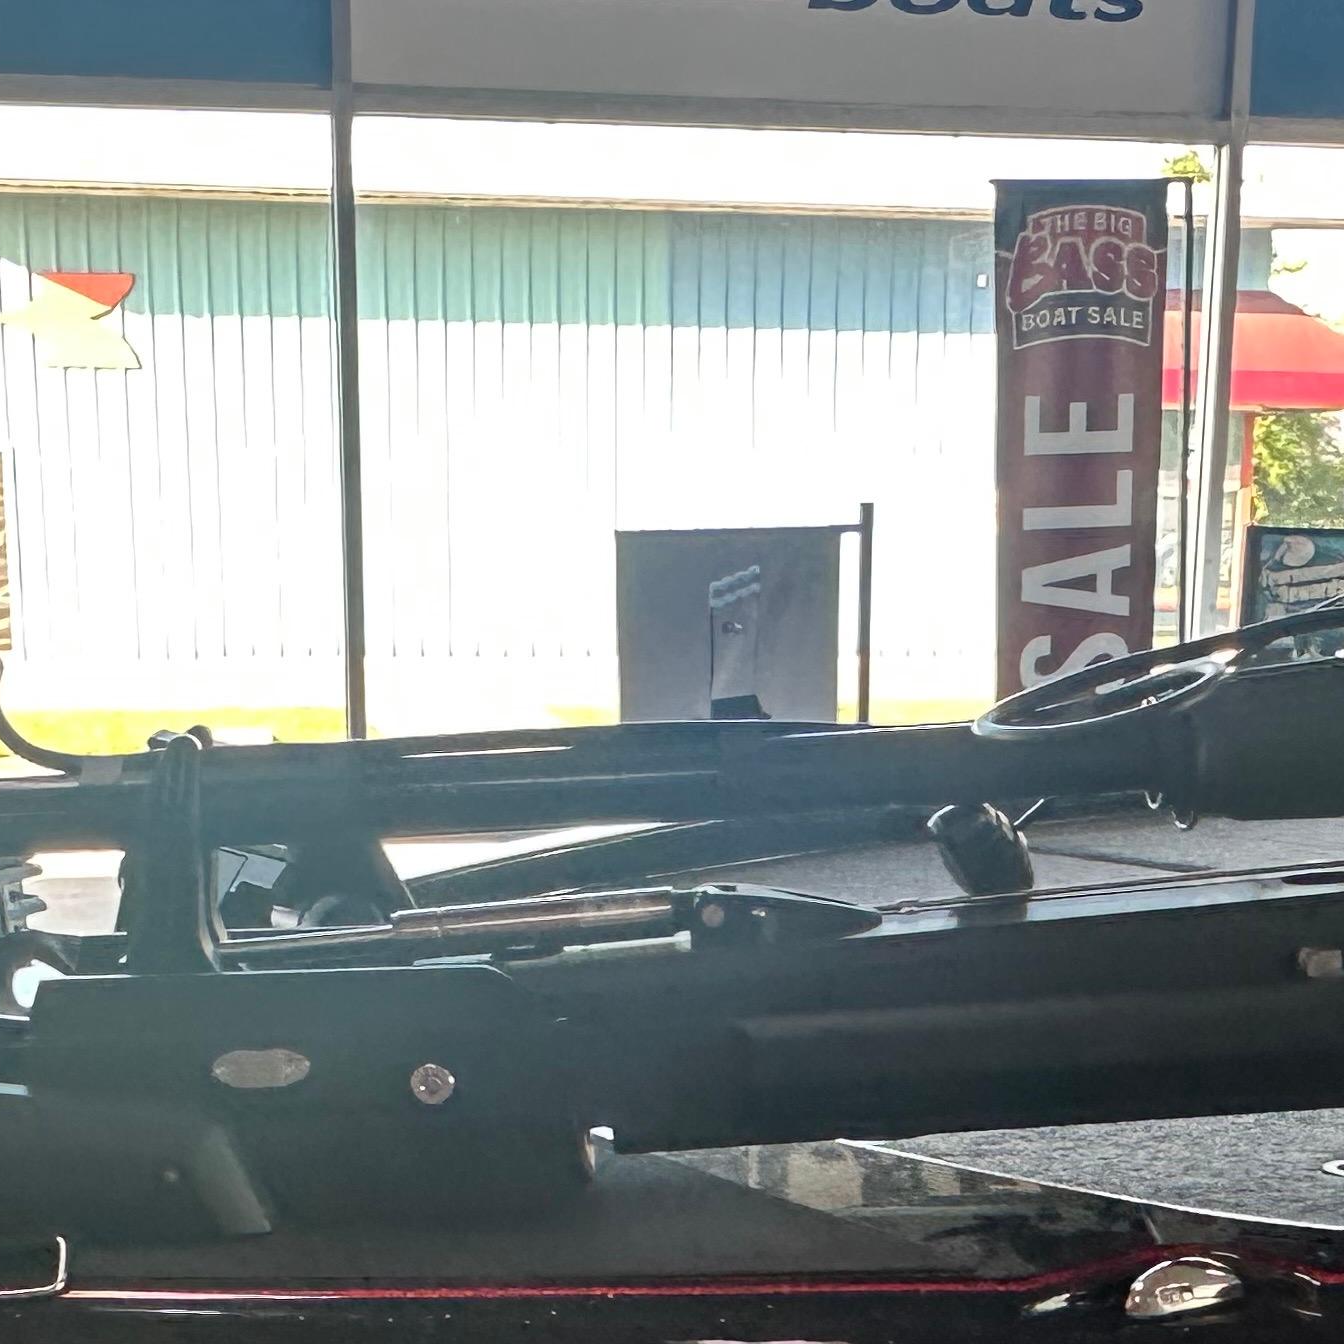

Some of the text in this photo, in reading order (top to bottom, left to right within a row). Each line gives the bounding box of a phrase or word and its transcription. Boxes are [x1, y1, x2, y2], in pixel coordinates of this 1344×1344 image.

[1040, 211, 1088, 235] THE
[1007, 231, 1158, 314] BASS
[1021, 306, 1145, 332] BOAT SALE
[1020, 393, 1134, 690] SALE
